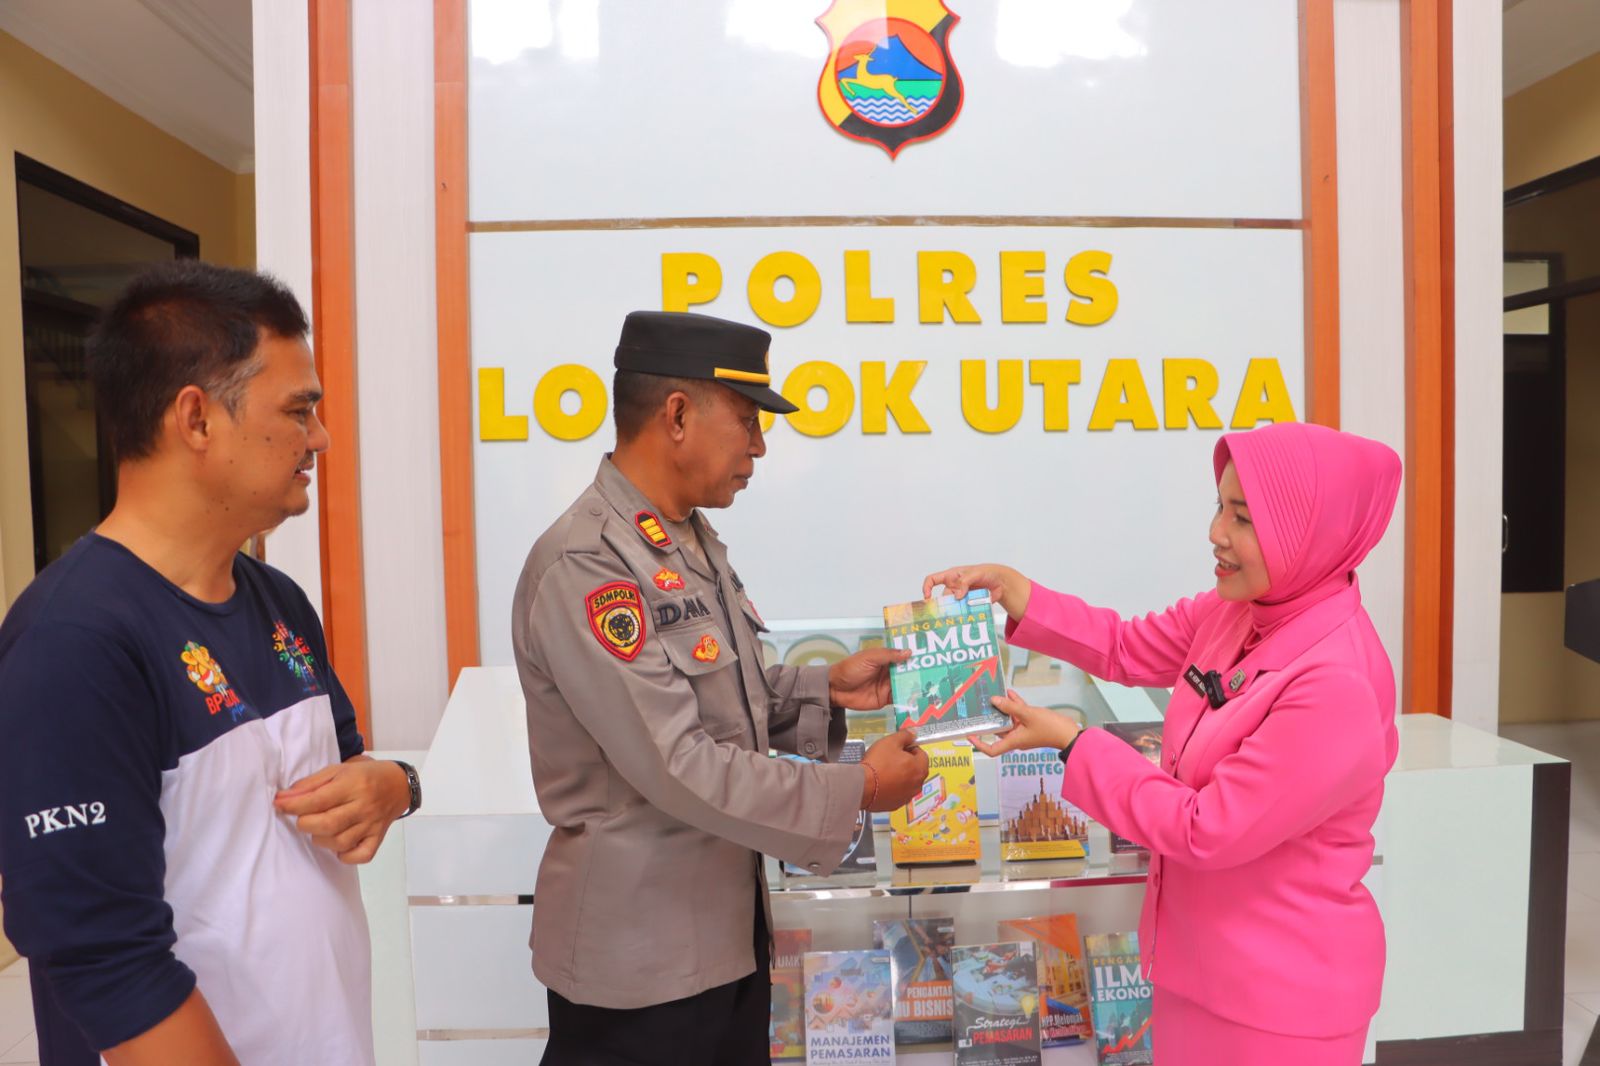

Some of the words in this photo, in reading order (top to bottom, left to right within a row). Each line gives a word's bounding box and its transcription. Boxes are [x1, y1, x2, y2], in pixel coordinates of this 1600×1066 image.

[661, 250, 1119, 328] POLRES
[478, 361, 932, 442] LOOK
[960, 358, 1298, 435] UTARA
[893, 621, 991, 657] ILMU
[896, 644, 994, 673] EKONOMI
[24, 801, 106, 839] PKN2
[1097, 984, 1154, 1001] EKONO
[810, 1034, 890, 1047] MANAJEMEN
[810, 1047, 891, 1060] PEMASARAN
